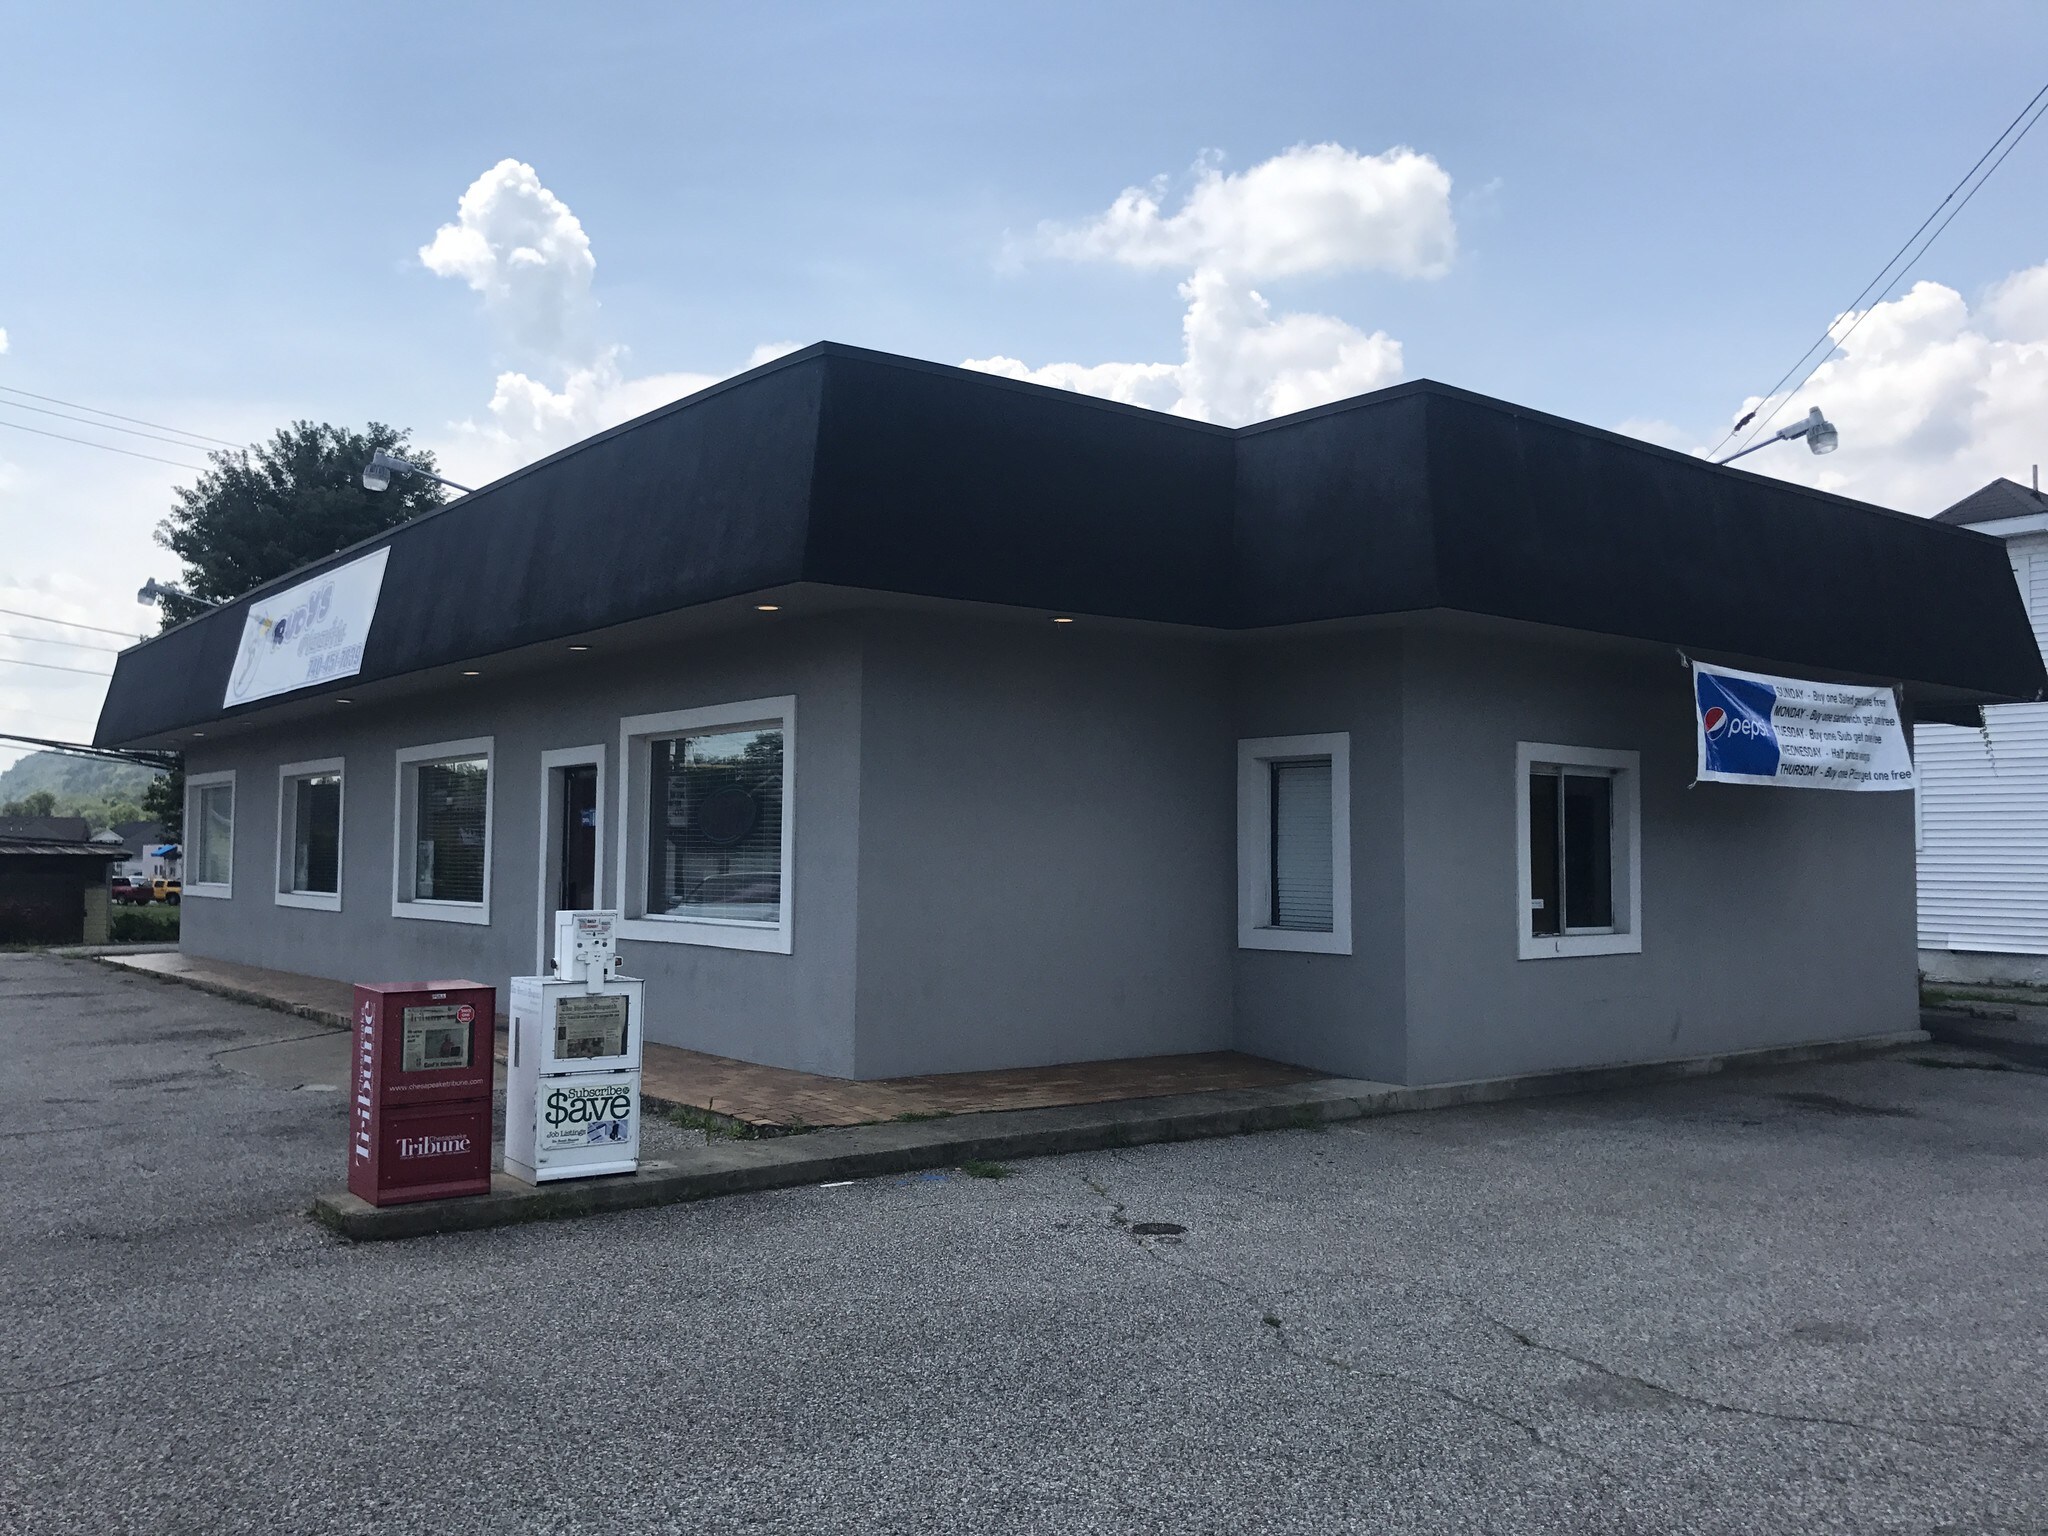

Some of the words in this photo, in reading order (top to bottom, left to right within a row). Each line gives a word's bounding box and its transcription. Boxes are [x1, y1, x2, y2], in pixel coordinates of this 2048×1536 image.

[1776, 686, 1804, 700] SUNDAY
[1813, 690, 1825, 704] Buy
[1826, 694, 1837, 703] one
[1773, 705, 1806, 719] MONDAY
[1810, 710, 1822, 724] Buy
[1833, 714, 1861, 725] sandwich
[1862, 716, 1874, 727] get
[1727, 717, 1769, 741] pepsi
[1774, 724, 1804, 739] TUESDAY
[1809, 729, 1822, 742] Buy
[1824, 732, 1836, 741] one
[1838, 731, 1852, 742] Sub
[1854, 732, 1864, 744] get
[1780, 744, 1821, 758] WEDNESDAY
[1831, 748, 1844, 760] Half
[1780, 763, 1819, 777] THURSDAY
[1824, 767, 1838, 780] Buy
[1860, 771, 1872, 783] get
[1873, 771, 1889, 780] one
[1891, 769, 1912, 781] free
[354, 1000, 374, 1167] Tribune
[389, 1078, 484, 1092] www.chesapeaketribune.com
[568, 1086, 622, 1099] Subscribe
[545, 1088, 631, 1129] $ave
[546, 1131, 559, 1139] Job
[560, 1129, 586, 1138] Listings
[396, 1136, 471, 1157] Tribune
